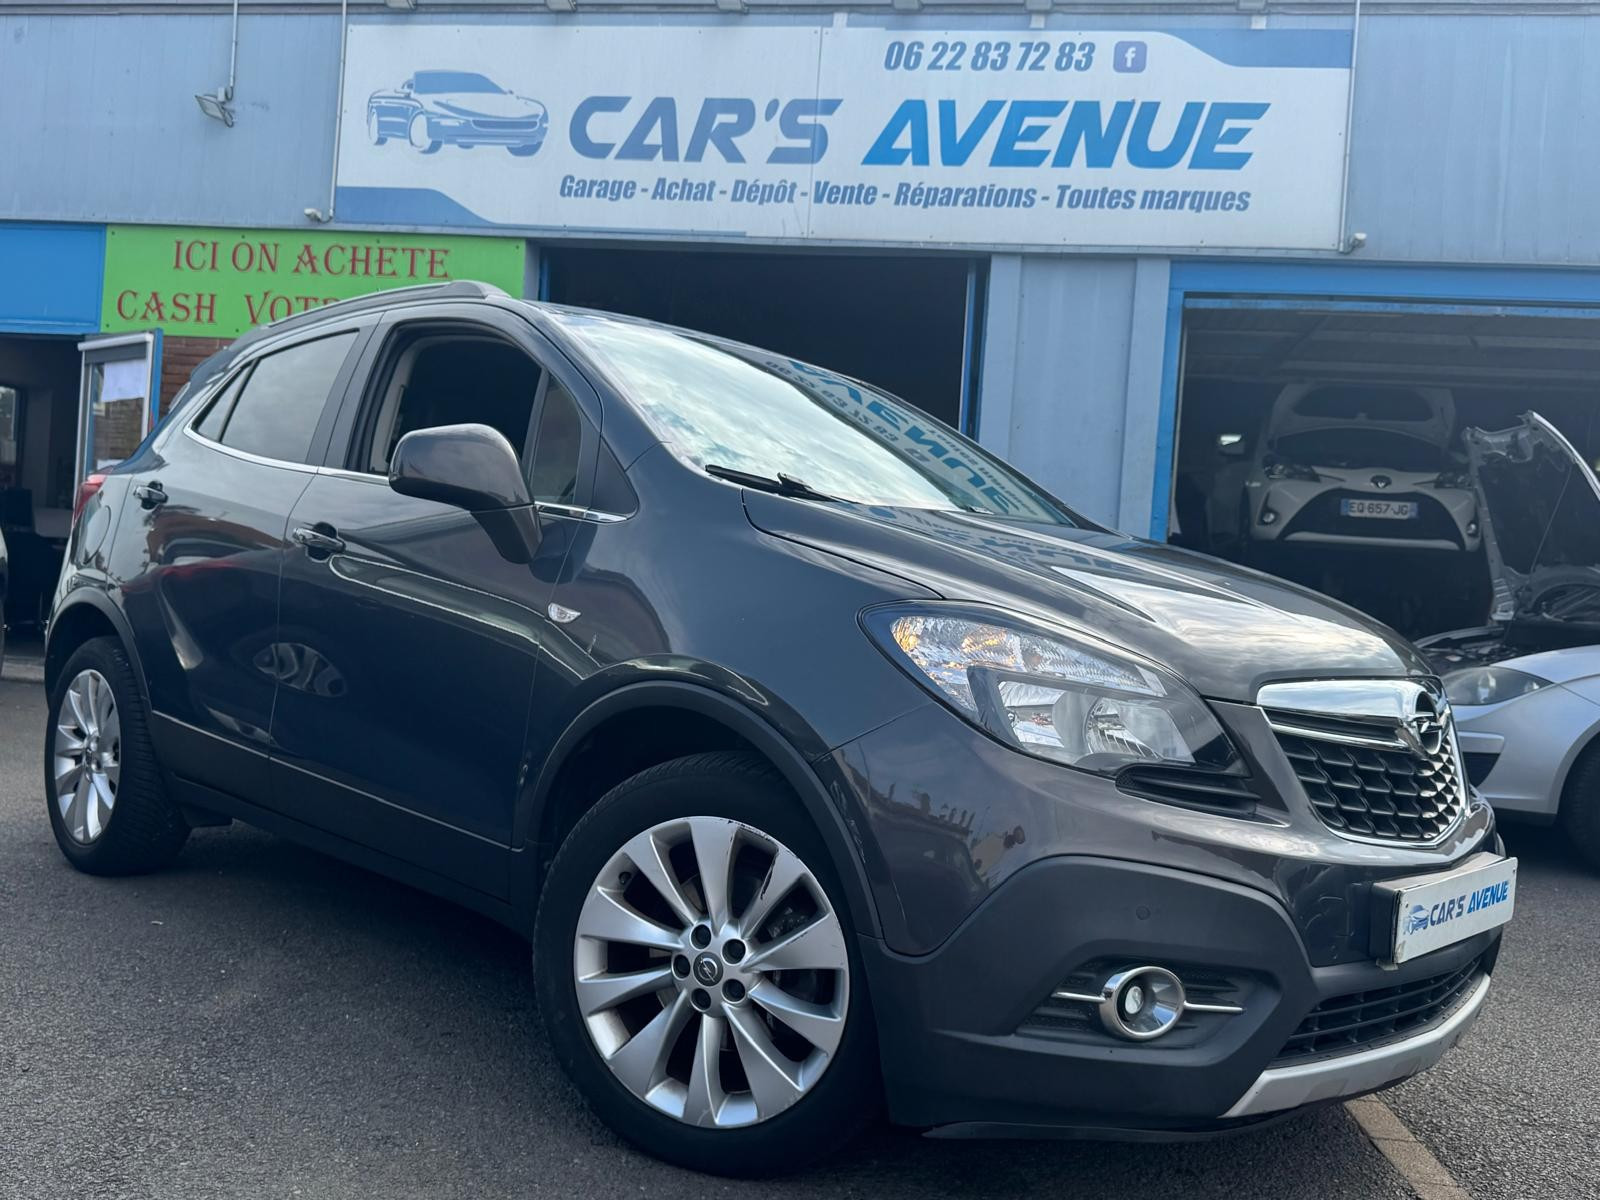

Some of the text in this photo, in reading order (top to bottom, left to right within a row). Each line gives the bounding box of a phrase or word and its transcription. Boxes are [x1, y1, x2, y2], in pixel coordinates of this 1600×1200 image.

[884, 41, 924, 71] 06
[927, 41, 967, 71] 22
[971, 41, 1011, 71] 83
[1016, 42, 1051, 71] 72
[1054, 41, 1095, 72] 83
[569, 96, 1271, 170] CAR'S AVENUE
[559, 174, 637, 202] Garage
[651, 177, 716, 202] Achat
[730, 179, 798, 206] Dépôt
[813, 180, 879, 206] Vente
[893, 182, 1037, 209] Réparations
[1055, 184, 1136, 210] Toutes
[1138, 188, 1252, 214] marques
[173, 240, 450, 278] ICI ON ACHETE
[117, 289, 340, 325] CASH VOT
[1430, 880, 1509, 926] CAR'S AVENUE
